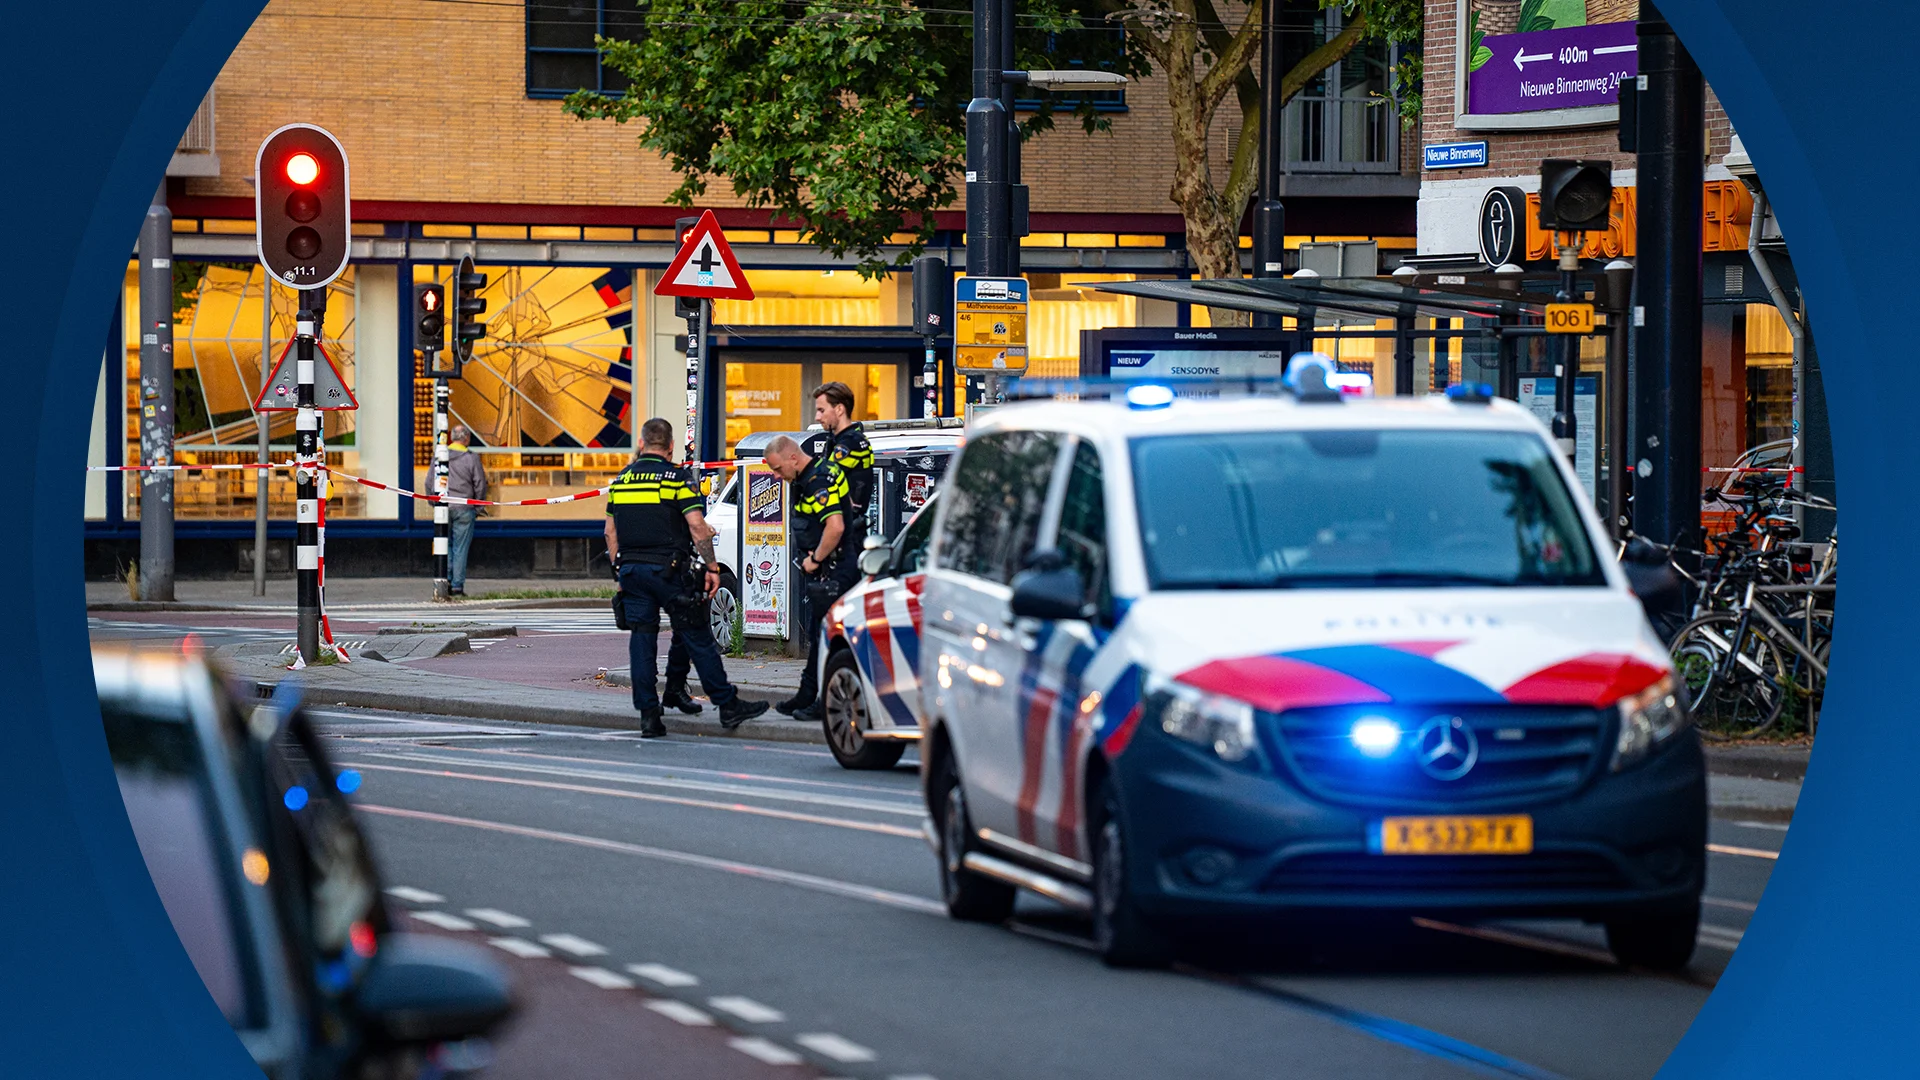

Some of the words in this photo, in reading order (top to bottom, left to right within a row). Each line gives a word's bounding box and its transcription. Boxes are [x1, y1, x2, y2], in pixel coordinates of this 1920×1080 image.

[1559, 46, 1588, 64] 400m
[1520, 80, 1554, 97] Nieuwe
[1556, 76, 1608, 95] Binnenweg
[1608, 71, 1628, 90] 24
[1427, 149, 1449, 161] Nieuwe
[1450, 147, 1483, 162] Binnenweg
[293, 266, 316, 276] 11.1
[966, 302, 1018, 311] Mathenesserlaan
[1549, 310, 1580, 327] 106
[1174, 332, 1195, 340] Bauer
[1196, 332, 1217, 340] Media
[1117, 357, 1141, 365] NIEUW
[1171, 366, 1220, 375] SENSODYNE
